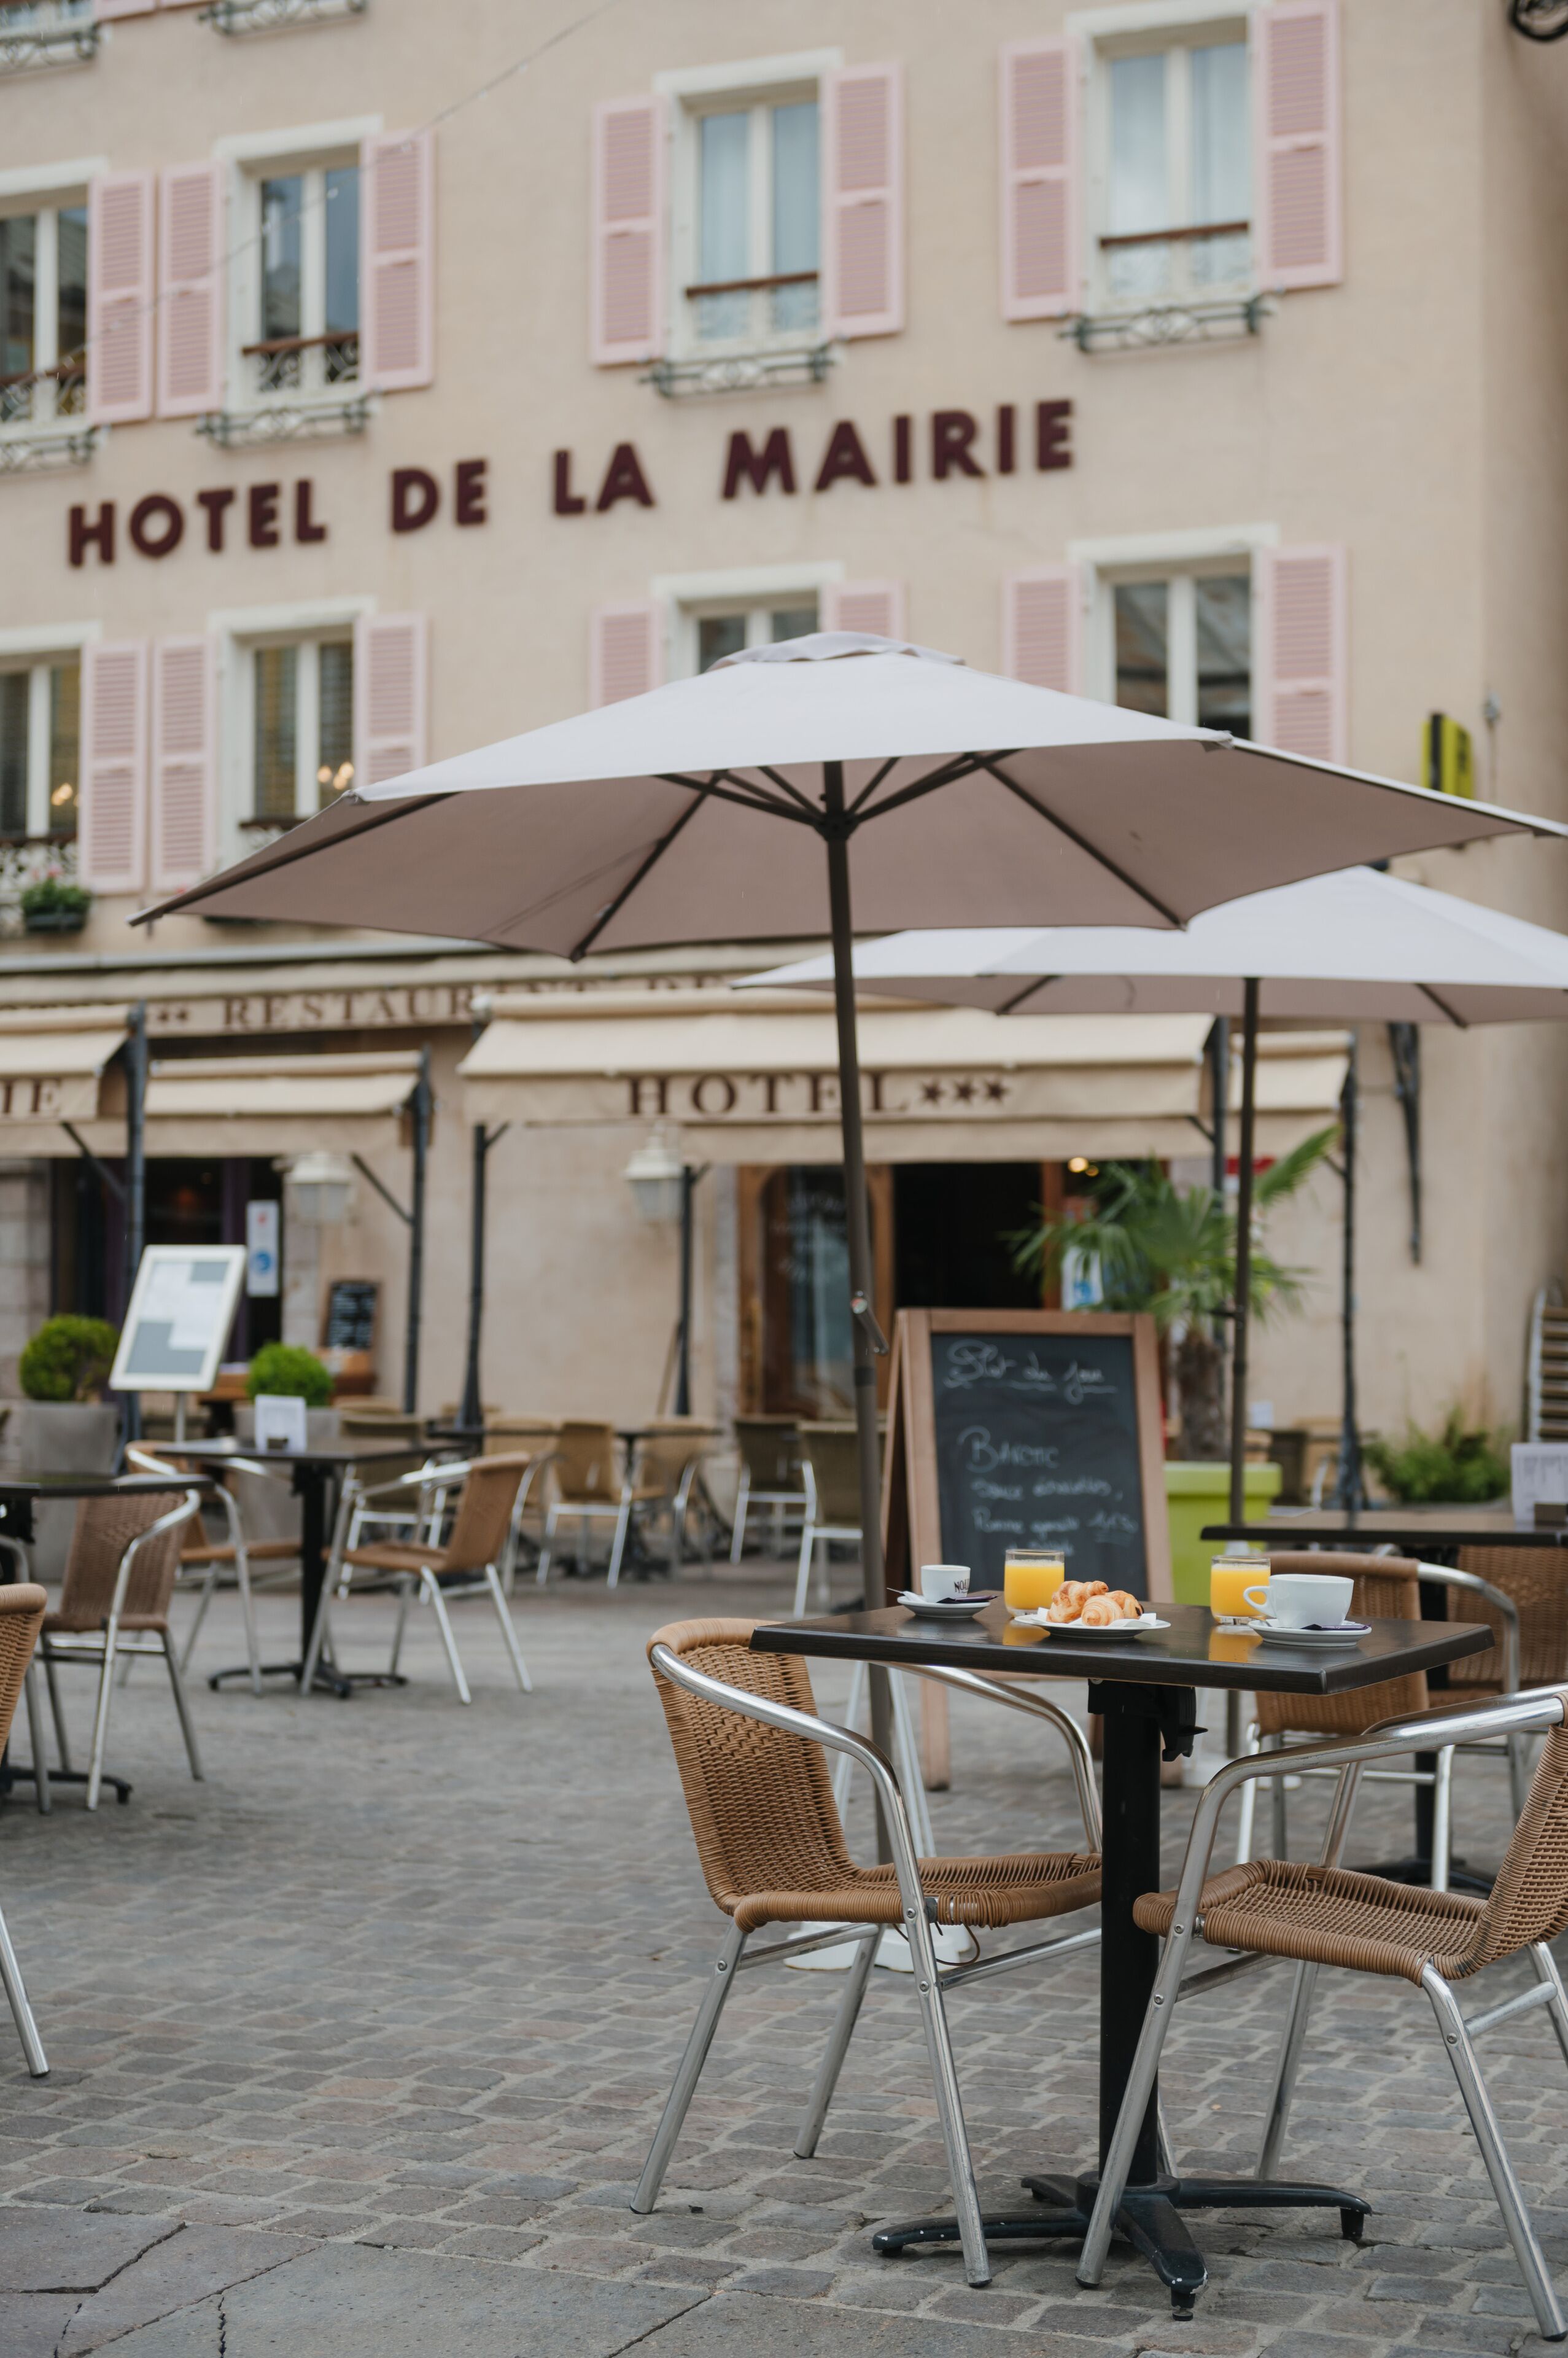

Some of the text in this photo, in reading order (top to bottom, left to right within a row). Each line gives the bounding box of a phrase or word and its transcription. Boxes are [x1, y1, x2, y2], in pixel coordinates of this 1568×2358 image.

[69, 399, 1074, 567] HOTEL DE LA MAIRIE
[627, 1073, 910, 1116] HOTEL
